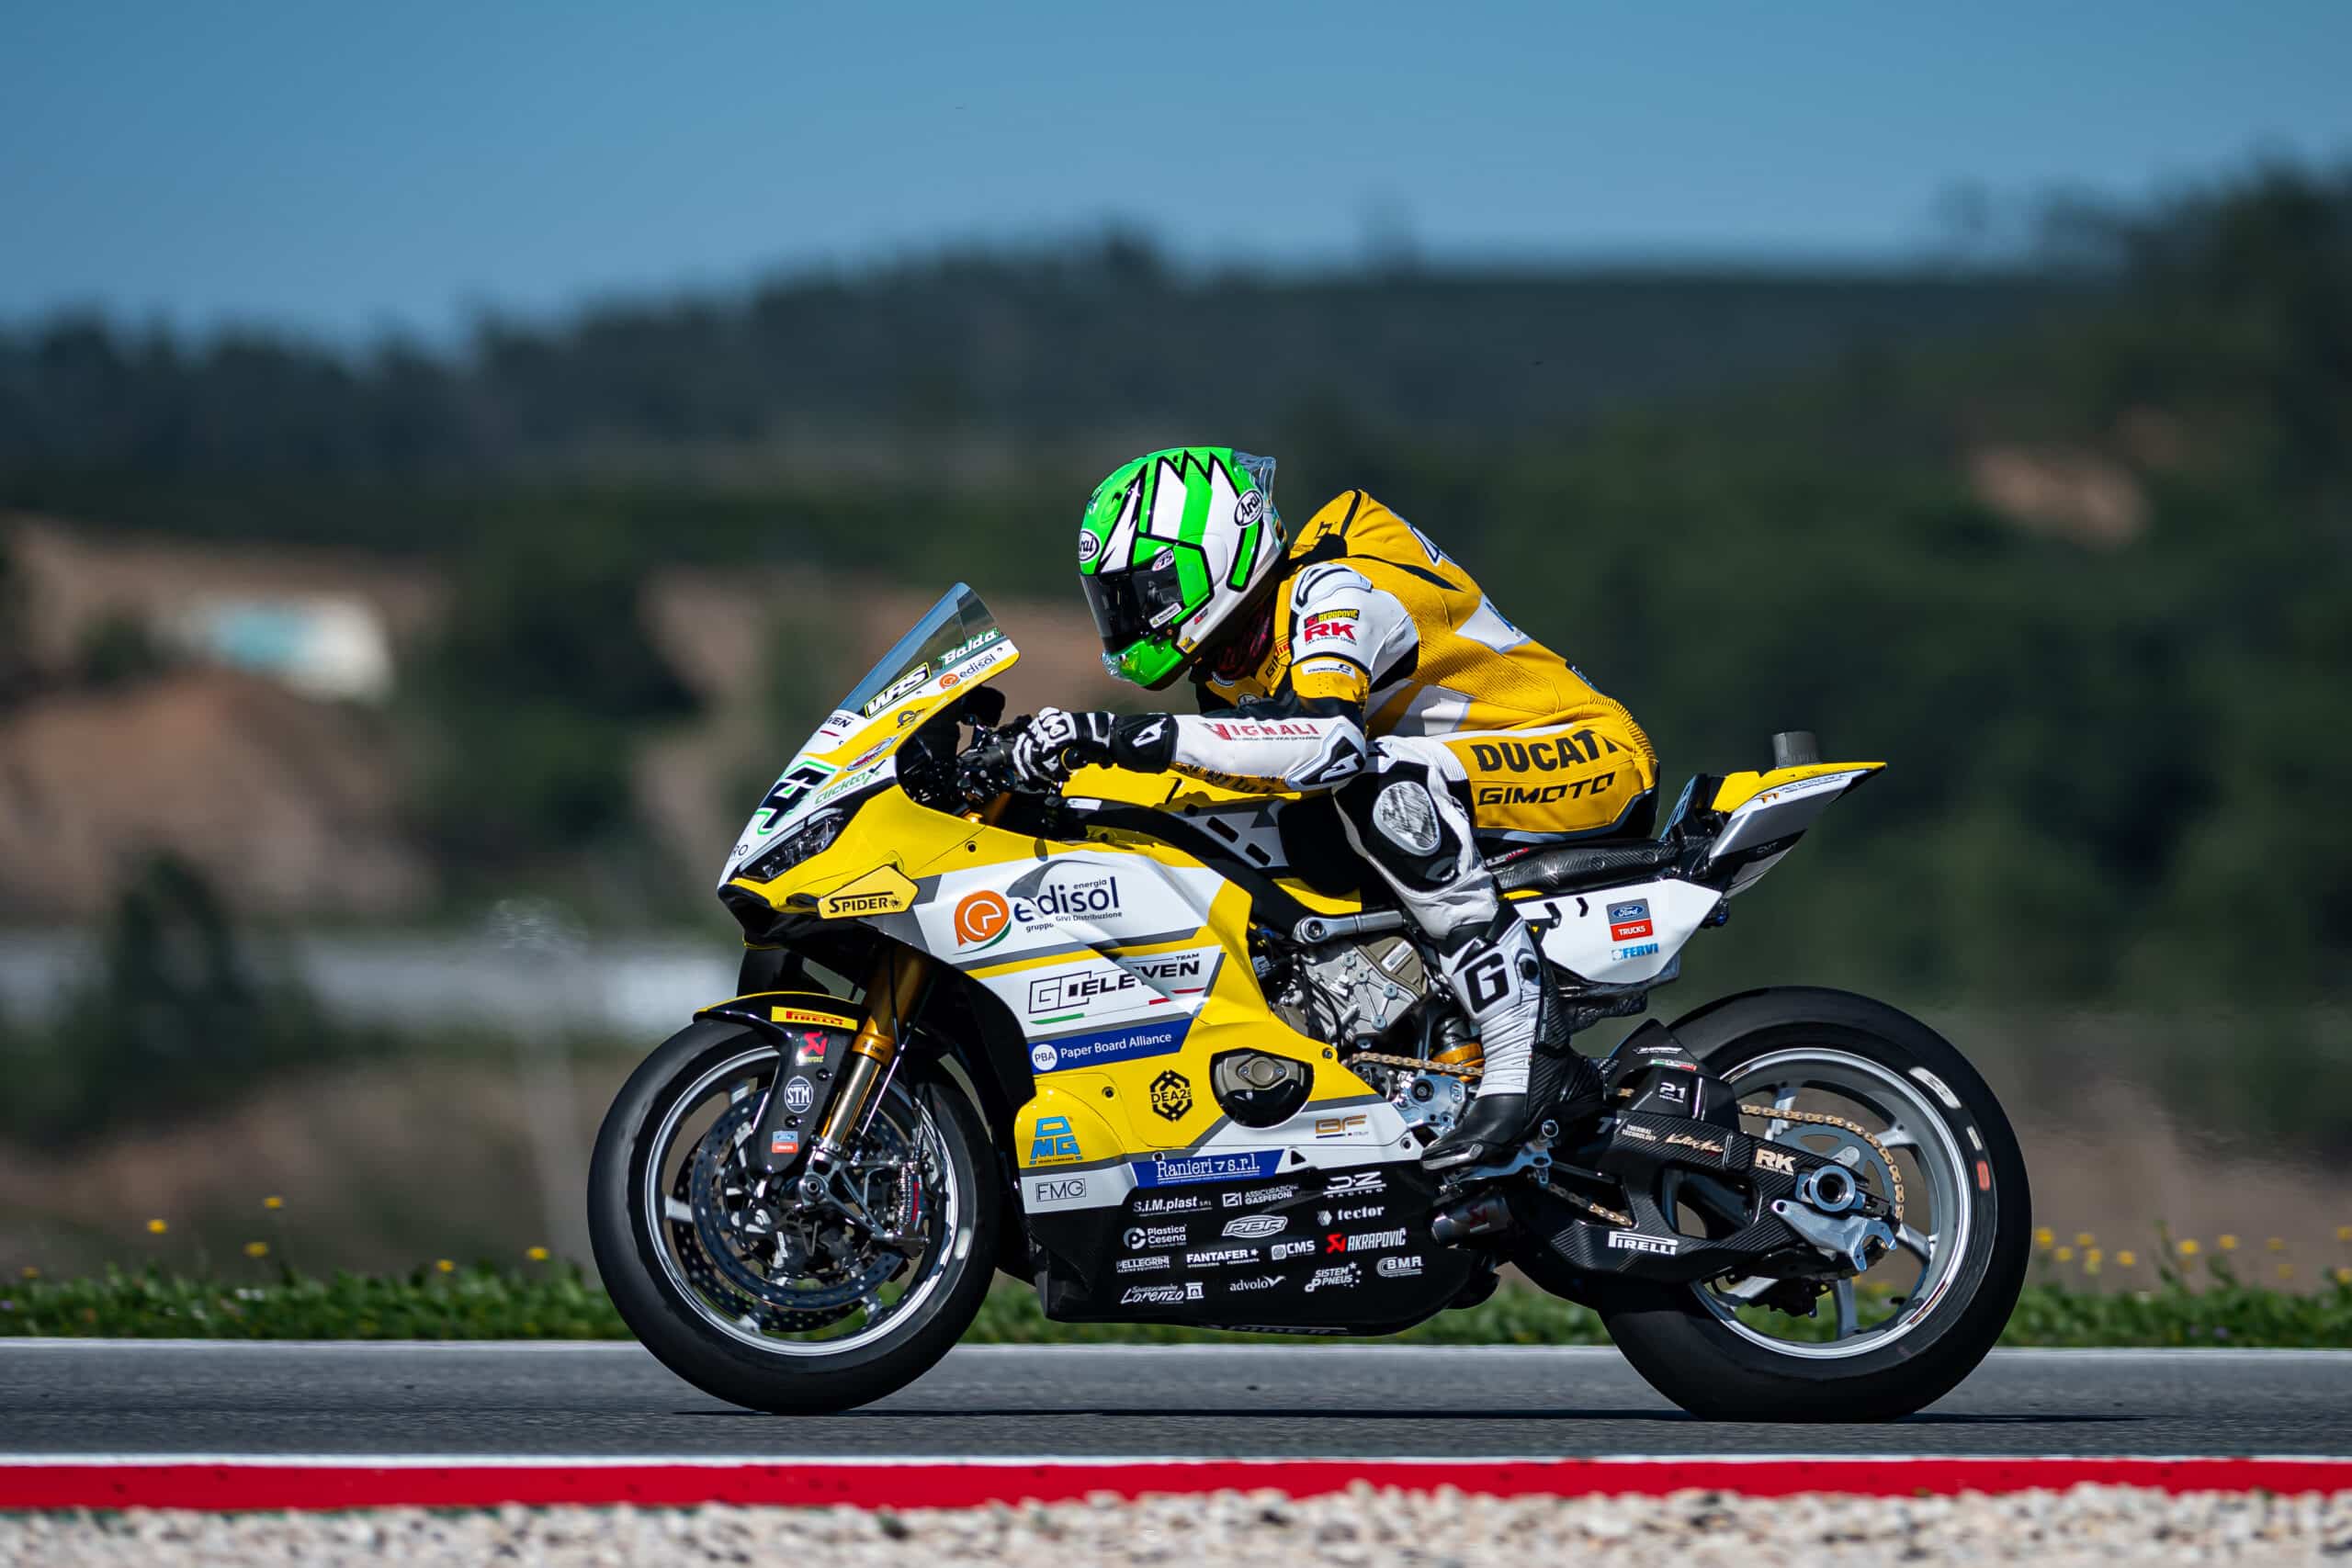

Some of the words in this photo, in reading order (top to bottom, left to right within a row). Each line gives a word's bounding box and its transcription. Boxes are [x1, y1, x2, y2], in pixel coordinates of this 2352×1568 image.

[1305, 622, 1357, 643] RK
[959, 653, 997, 678] edisol
[1477, 772, 1616, 807] GIMOTO
[1073, 879, 1107, 891] energia
[829, 891, 893, 914] SPIDER
[1013, 875, 1120, 923] edisol
[1618, 925, 1646, 936] TRUCKS
[1176, 953, 1200, 961] TEAM
[1623, 942, 1659, 959] FERVI
[1060, 1045, 1092, 1059] Paper
[1094, 1040, 1127, 1054] Board
[1129, 1033, 1172, 1048] Alliance
[1035, 1051, 1055, 1063] PBA
[786, 1086, 810, 1104] STM
[1156, 1157, 1214, 1179] Ranieri
[1756, 1148, 1796, 1172] RK
[1037, 1180, 1084, 1201] FMG
[1148, 1225, 1186, 1235] Plastica
[1148, 1234, 1186, 1244] Cesena
[1287, 1240, 1316, 1254] CMS
[1608, 1230, 1679, 1256] PIRELLI
[1116, 1255, 1170, 1269] PELLEGRINI
[1186, 1249, 1249, 1264] FANTAFER
[1315, 1266, 1349, 1279] SISTEM
[1322, 1274, 1352, 1286] PNEUS
